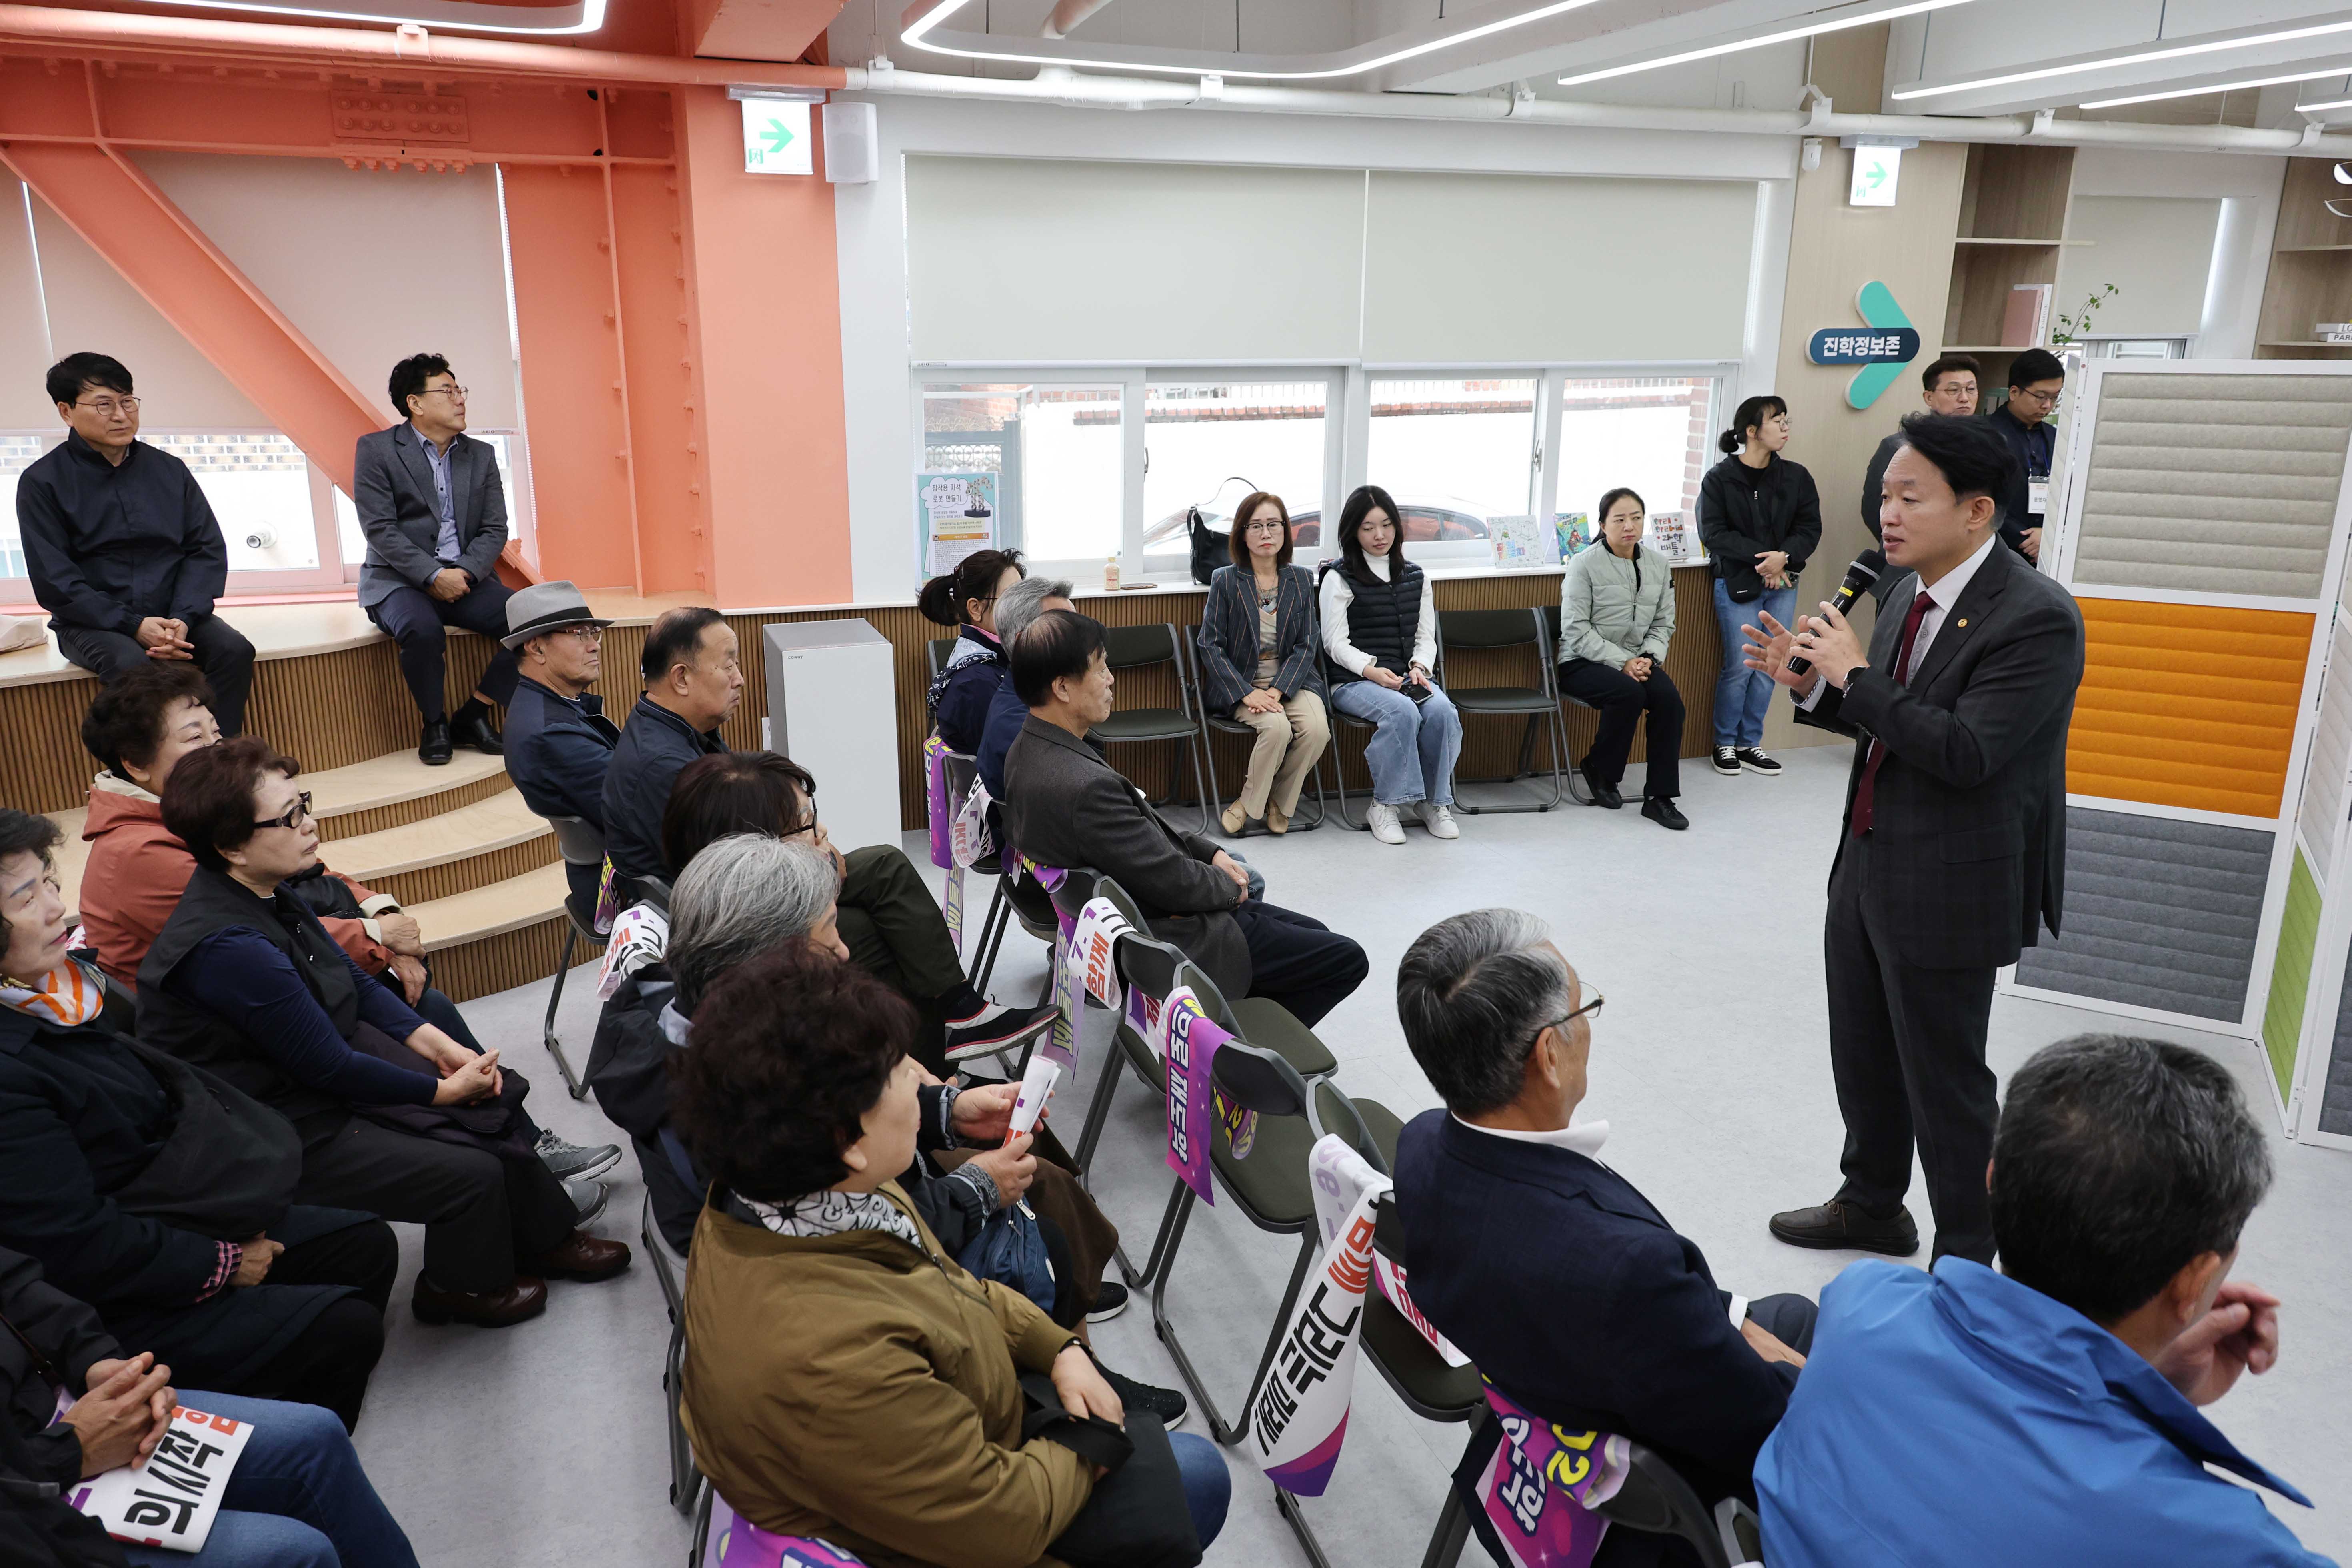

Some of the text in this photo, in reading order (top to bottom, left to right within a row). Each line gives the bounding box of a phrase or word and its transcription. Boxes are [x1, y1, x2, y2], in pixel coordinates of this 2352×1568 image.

[1824, 336, 1900, 356] 진학정보존
[1661, 542, 1679, 555] 배틀
[1280, 1281, 1362, 1396] 그리는
[1255, 1368, 1298, 1457] 미래!
[147, 1428, 224, 1497] 시작
[116, 1488, 200, 1540] 의
